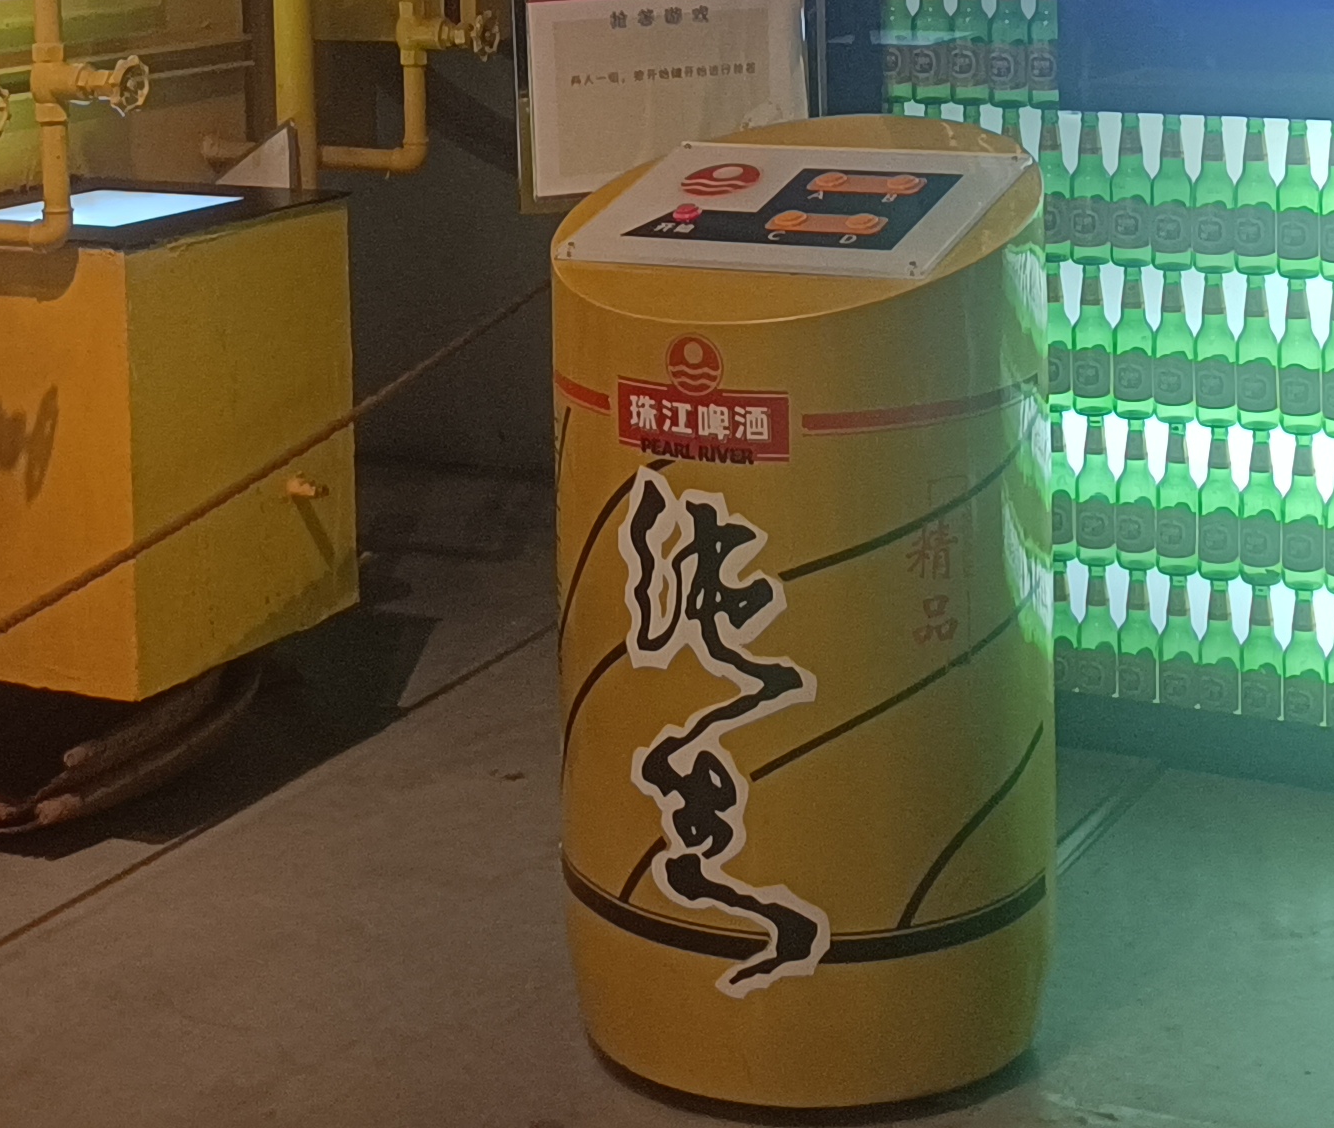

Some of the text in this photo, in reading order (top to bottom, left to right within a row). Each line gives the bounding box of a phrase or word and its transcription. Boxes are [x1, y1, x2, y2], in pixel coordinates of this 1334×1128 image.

[807, 190, 824, 200] A
[767, 230, 857, 245] C D
[629, 394, 770, 441] 珠江啤酒
[640, 437, 755, 465] PEARL RIVER
[905, 523, 959, 645] 精品
